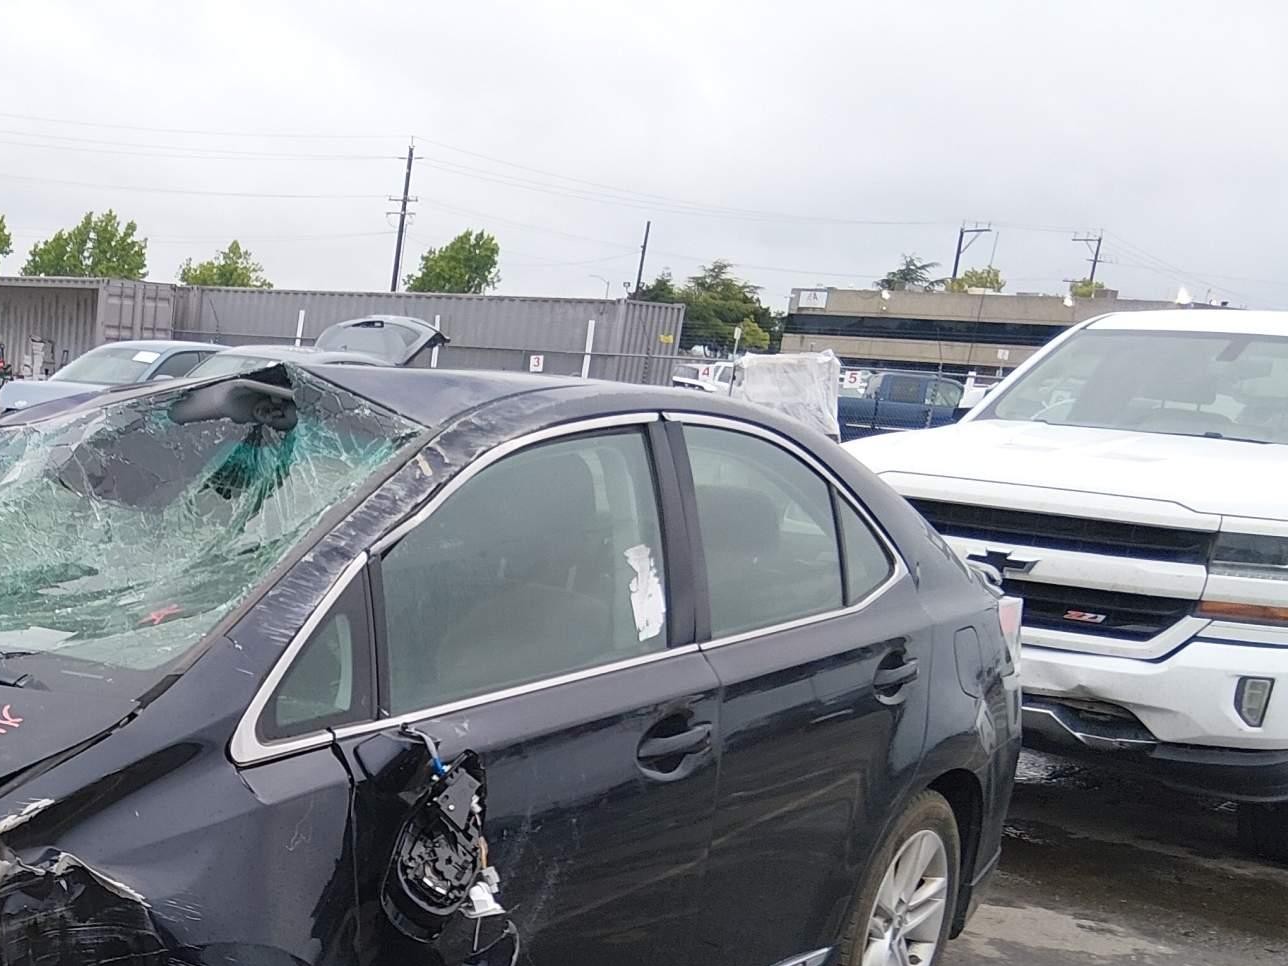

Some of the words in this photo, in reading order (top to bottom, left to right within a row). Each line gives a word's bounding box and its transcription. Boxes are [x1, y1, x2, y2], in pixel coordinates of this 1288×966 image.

[533, 356, 541, 368] 3
[701, 367, 710, 377] 4
[847, 372, 858, 384] 5
